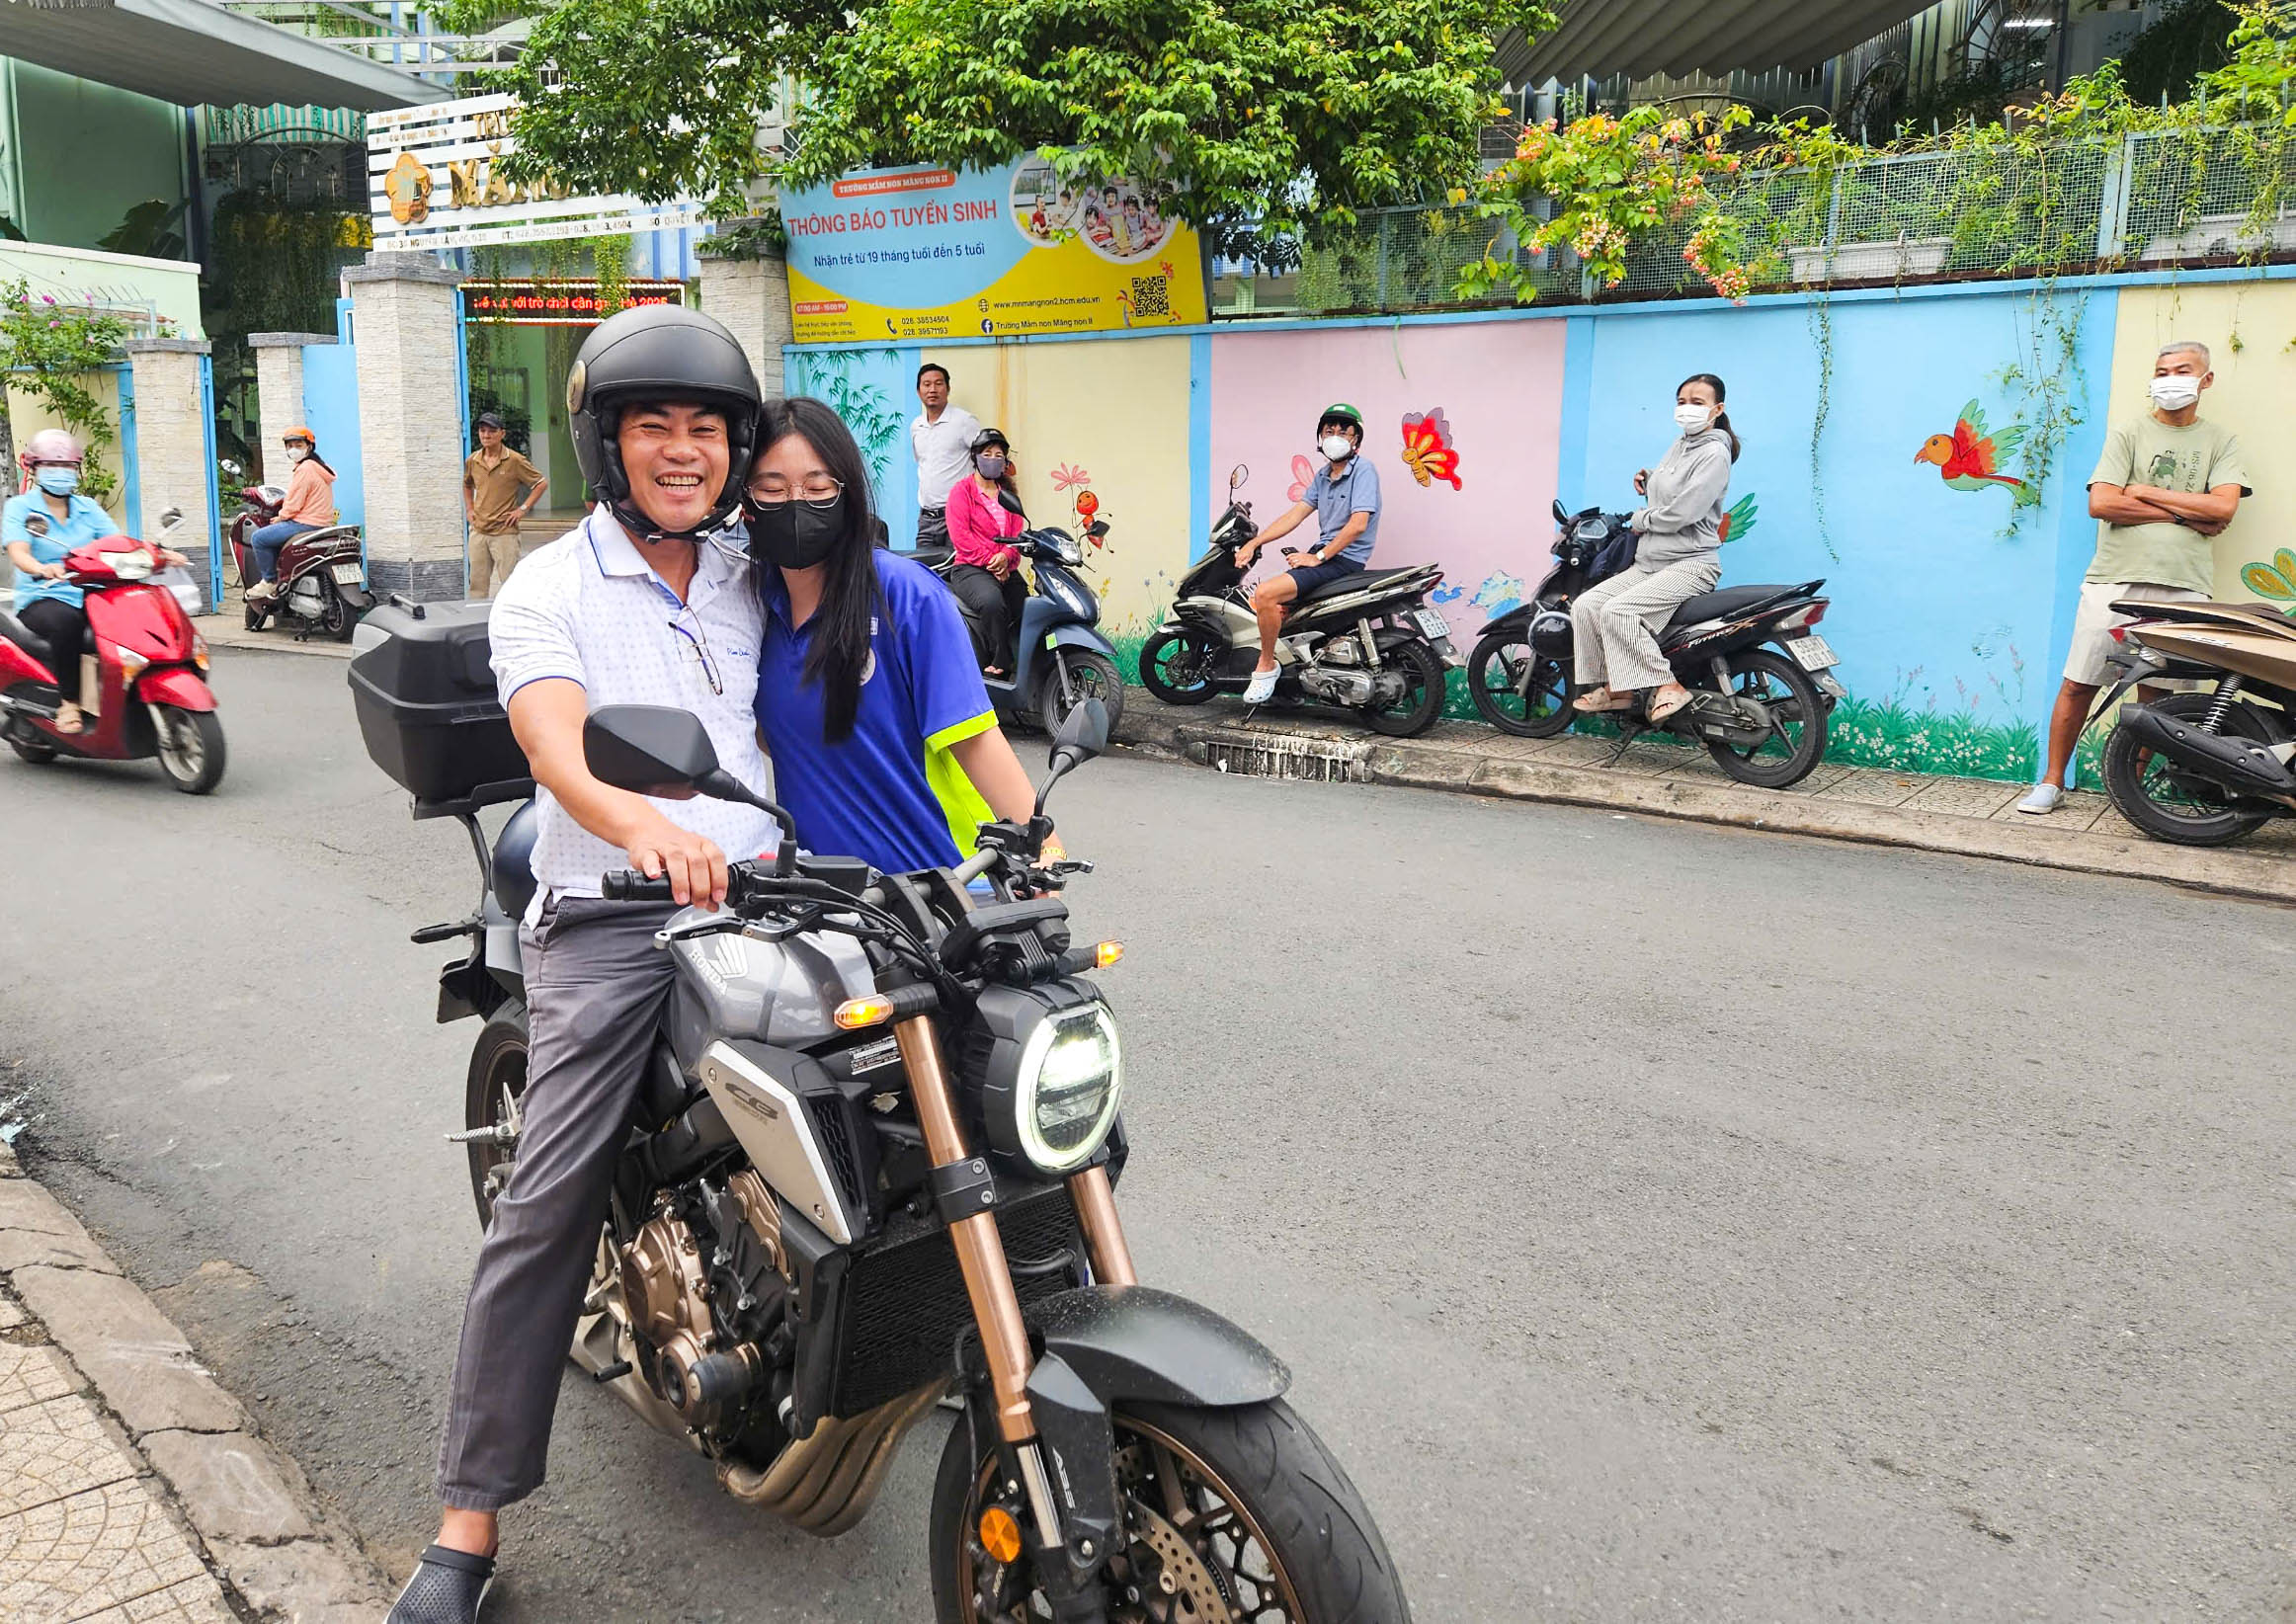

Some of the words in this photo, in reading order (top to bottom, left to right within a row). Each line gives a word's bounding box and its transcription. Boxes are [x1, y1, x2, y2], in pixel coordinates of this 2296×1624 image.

[787, 212, 847, 237] THÔNG
[851, 207, 886, 231] BÁO
[891, 200, 948, 228] TUYỂN
[953, 200, 997, 222] SINH
[814, 255, 839, 268] Nhận
[841, 254, 854, 266] trẻ
[856, 251, 865, 264] từ
[868, 252, 878, 263] 19
[881, 249, 910, 263] tháng
[912, 245, 932, 259] tuổi
[934, 242, 953, 259] đến
[956, 244, 962, 256] 5
[965, 242, 985, 255] tuổi
[689, 948, 728, 997] HONDA
[724, 1082, 779, 1120] CB
[1052, 1446, 1076, 1509] ABS
